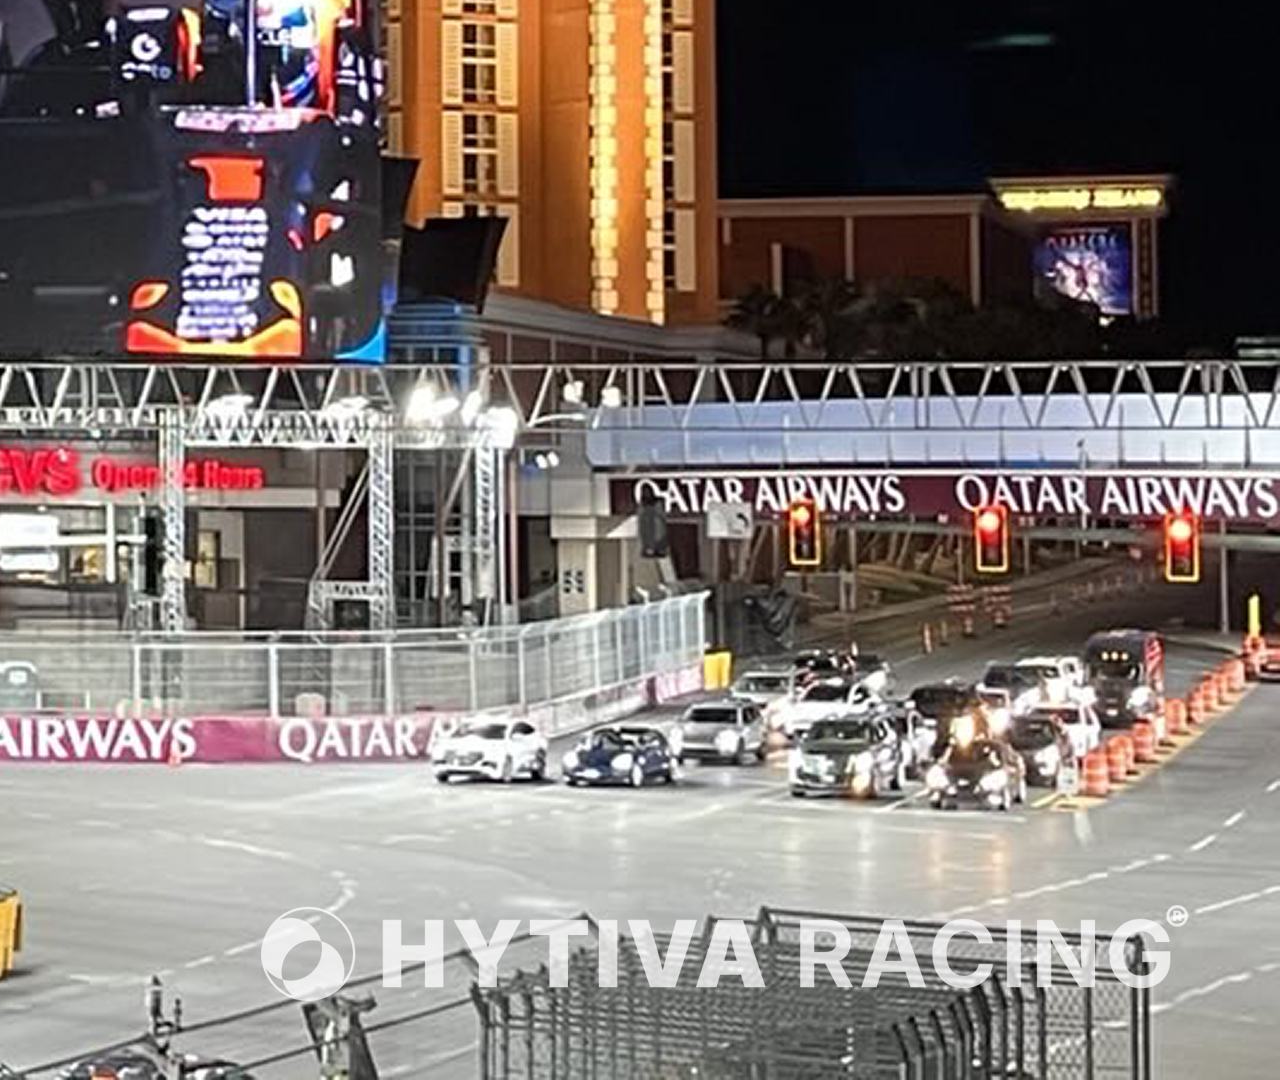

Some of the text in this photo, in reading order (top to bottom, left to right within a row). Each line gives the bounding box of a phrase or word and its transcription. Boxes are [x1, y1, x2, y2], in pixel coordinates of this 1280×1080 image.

[93, 458, 162, 494] Open
[203, 459, 264, 489] Hours
[755, 476, 906, 513] AIRWAYS
[955, 474, 1092, 514] QATAR
[1100, 476, 1279, 519] AIRWAYS
[278, 717, 418, 763] QATAR
